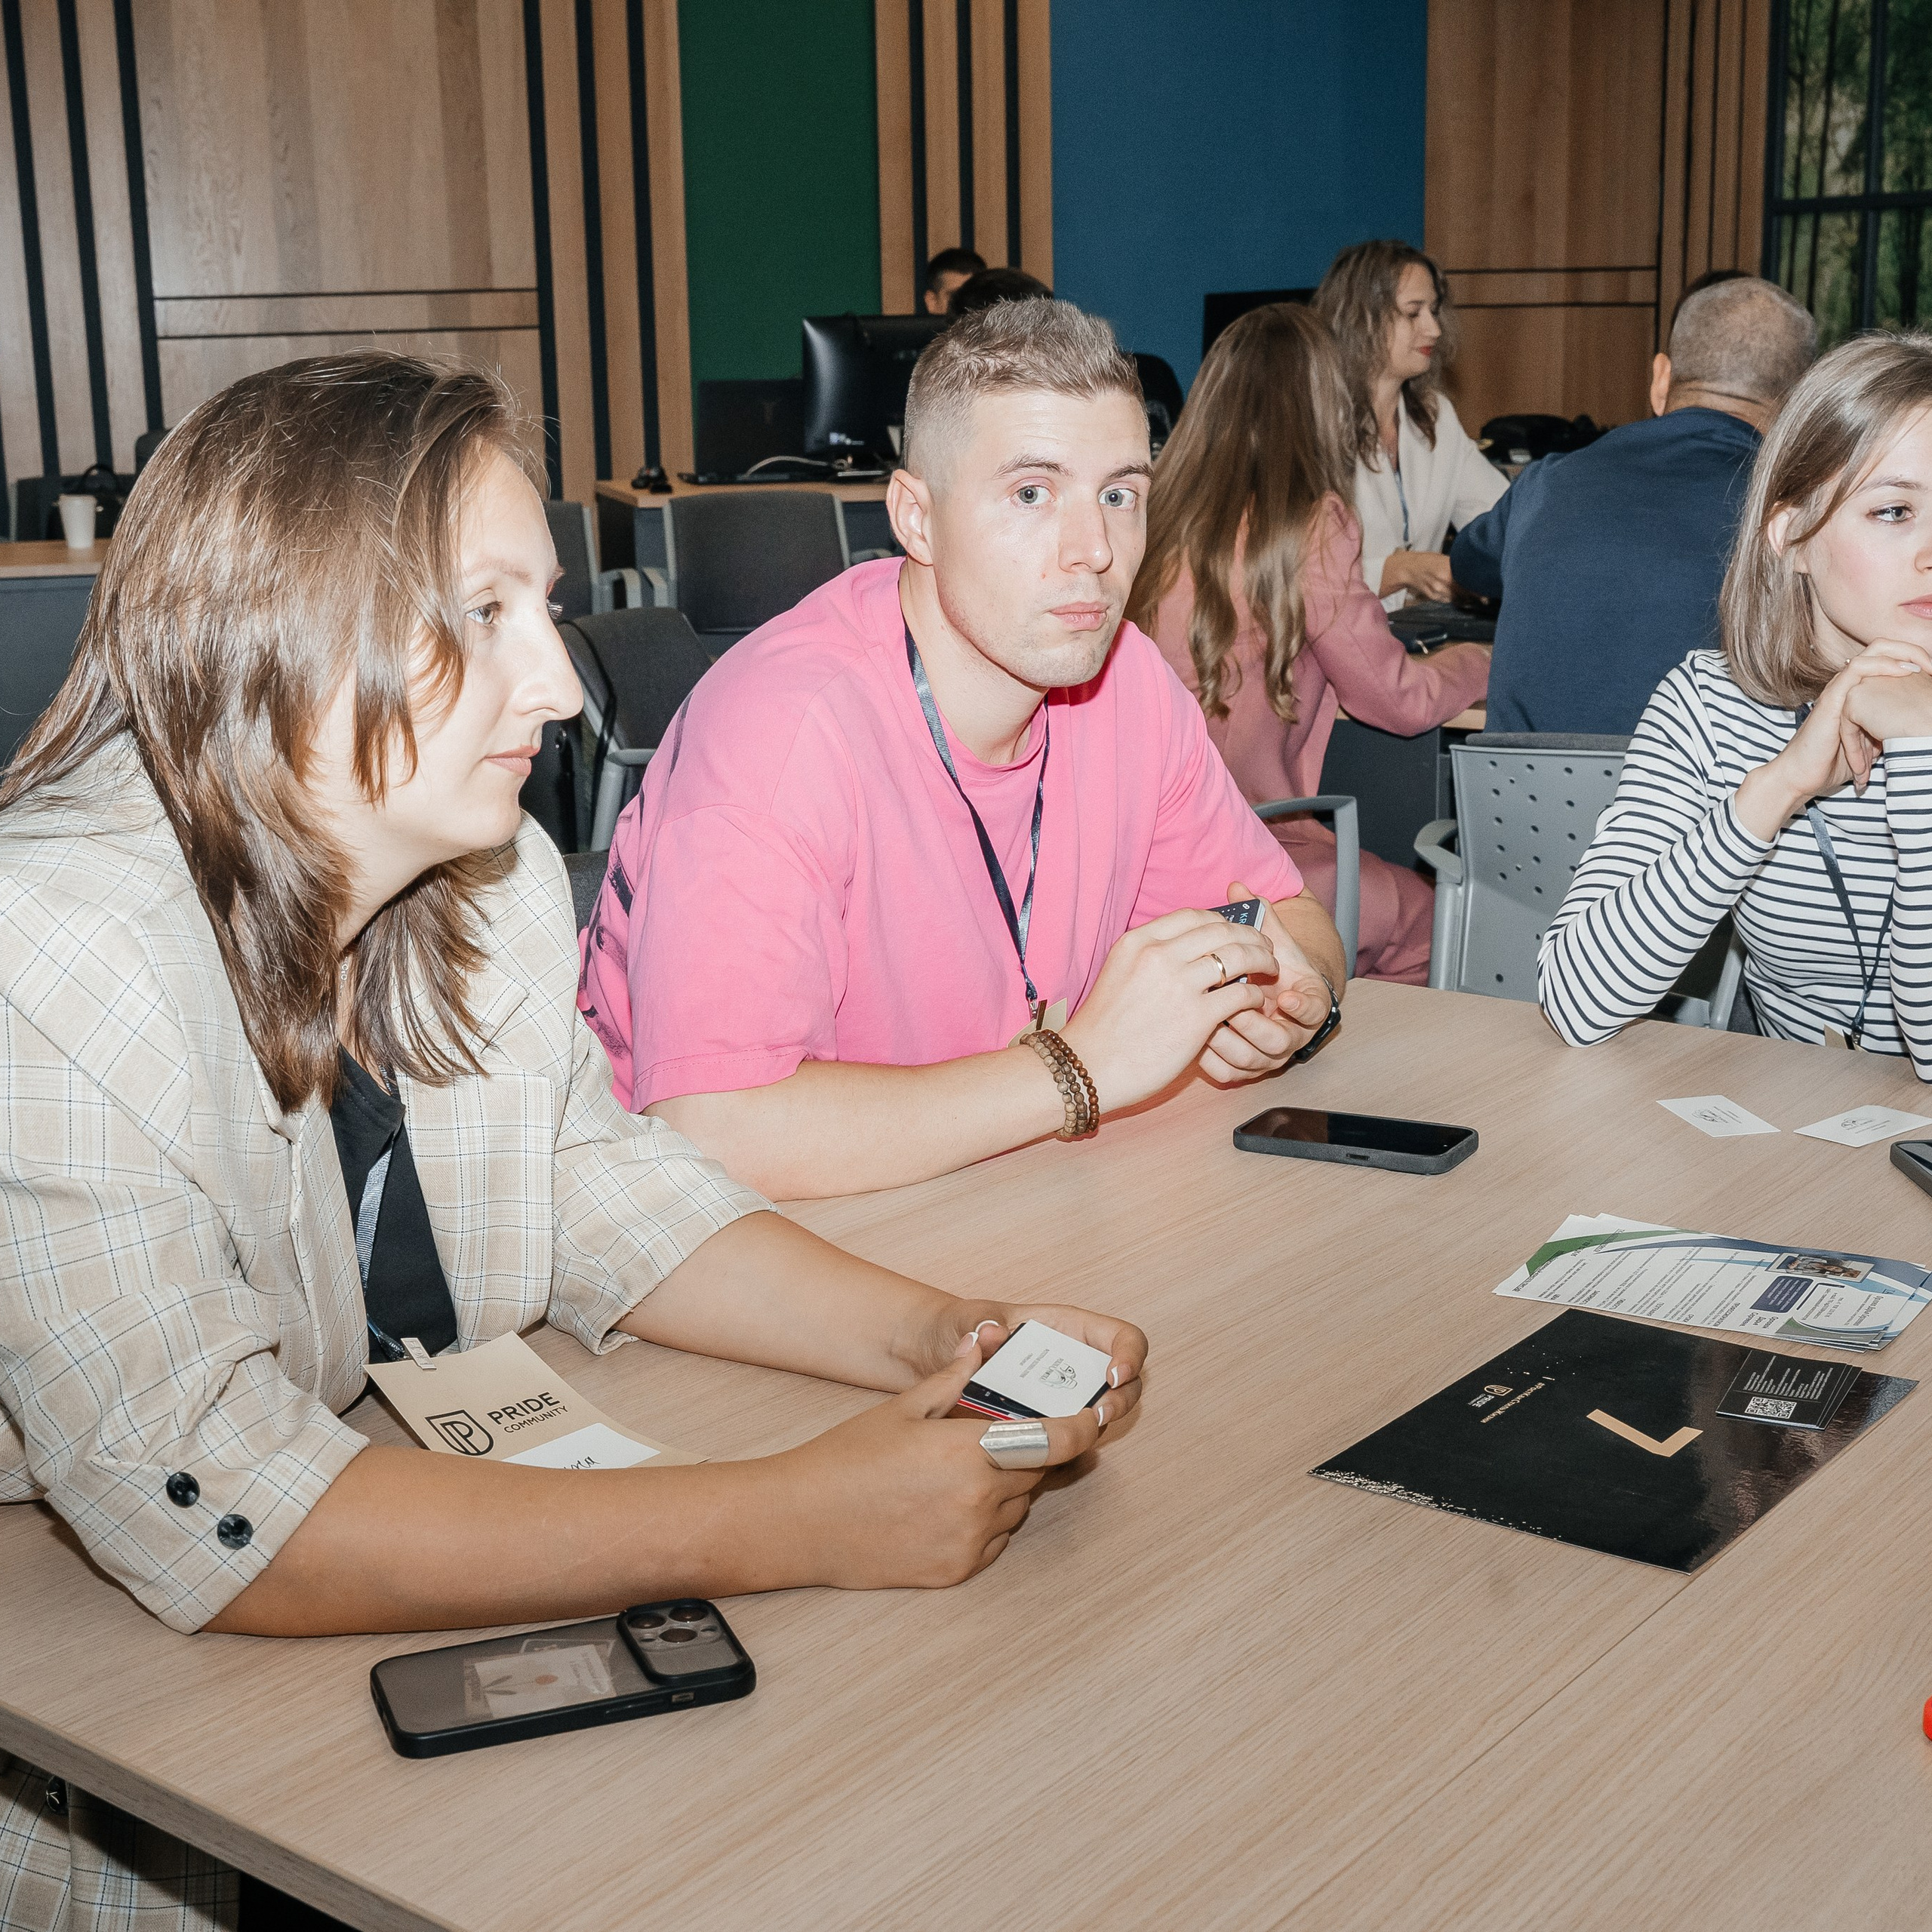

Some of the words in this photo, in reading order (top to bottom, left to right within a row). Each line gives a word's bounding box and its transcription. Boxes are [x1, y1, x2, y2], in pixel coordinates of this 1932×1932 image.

[487, 1392, 560, 1425] PRIDE
[1472, 1395, 1495, 1408] PRIDE
[503, 1405, 568, 1433] COMMUNITY
